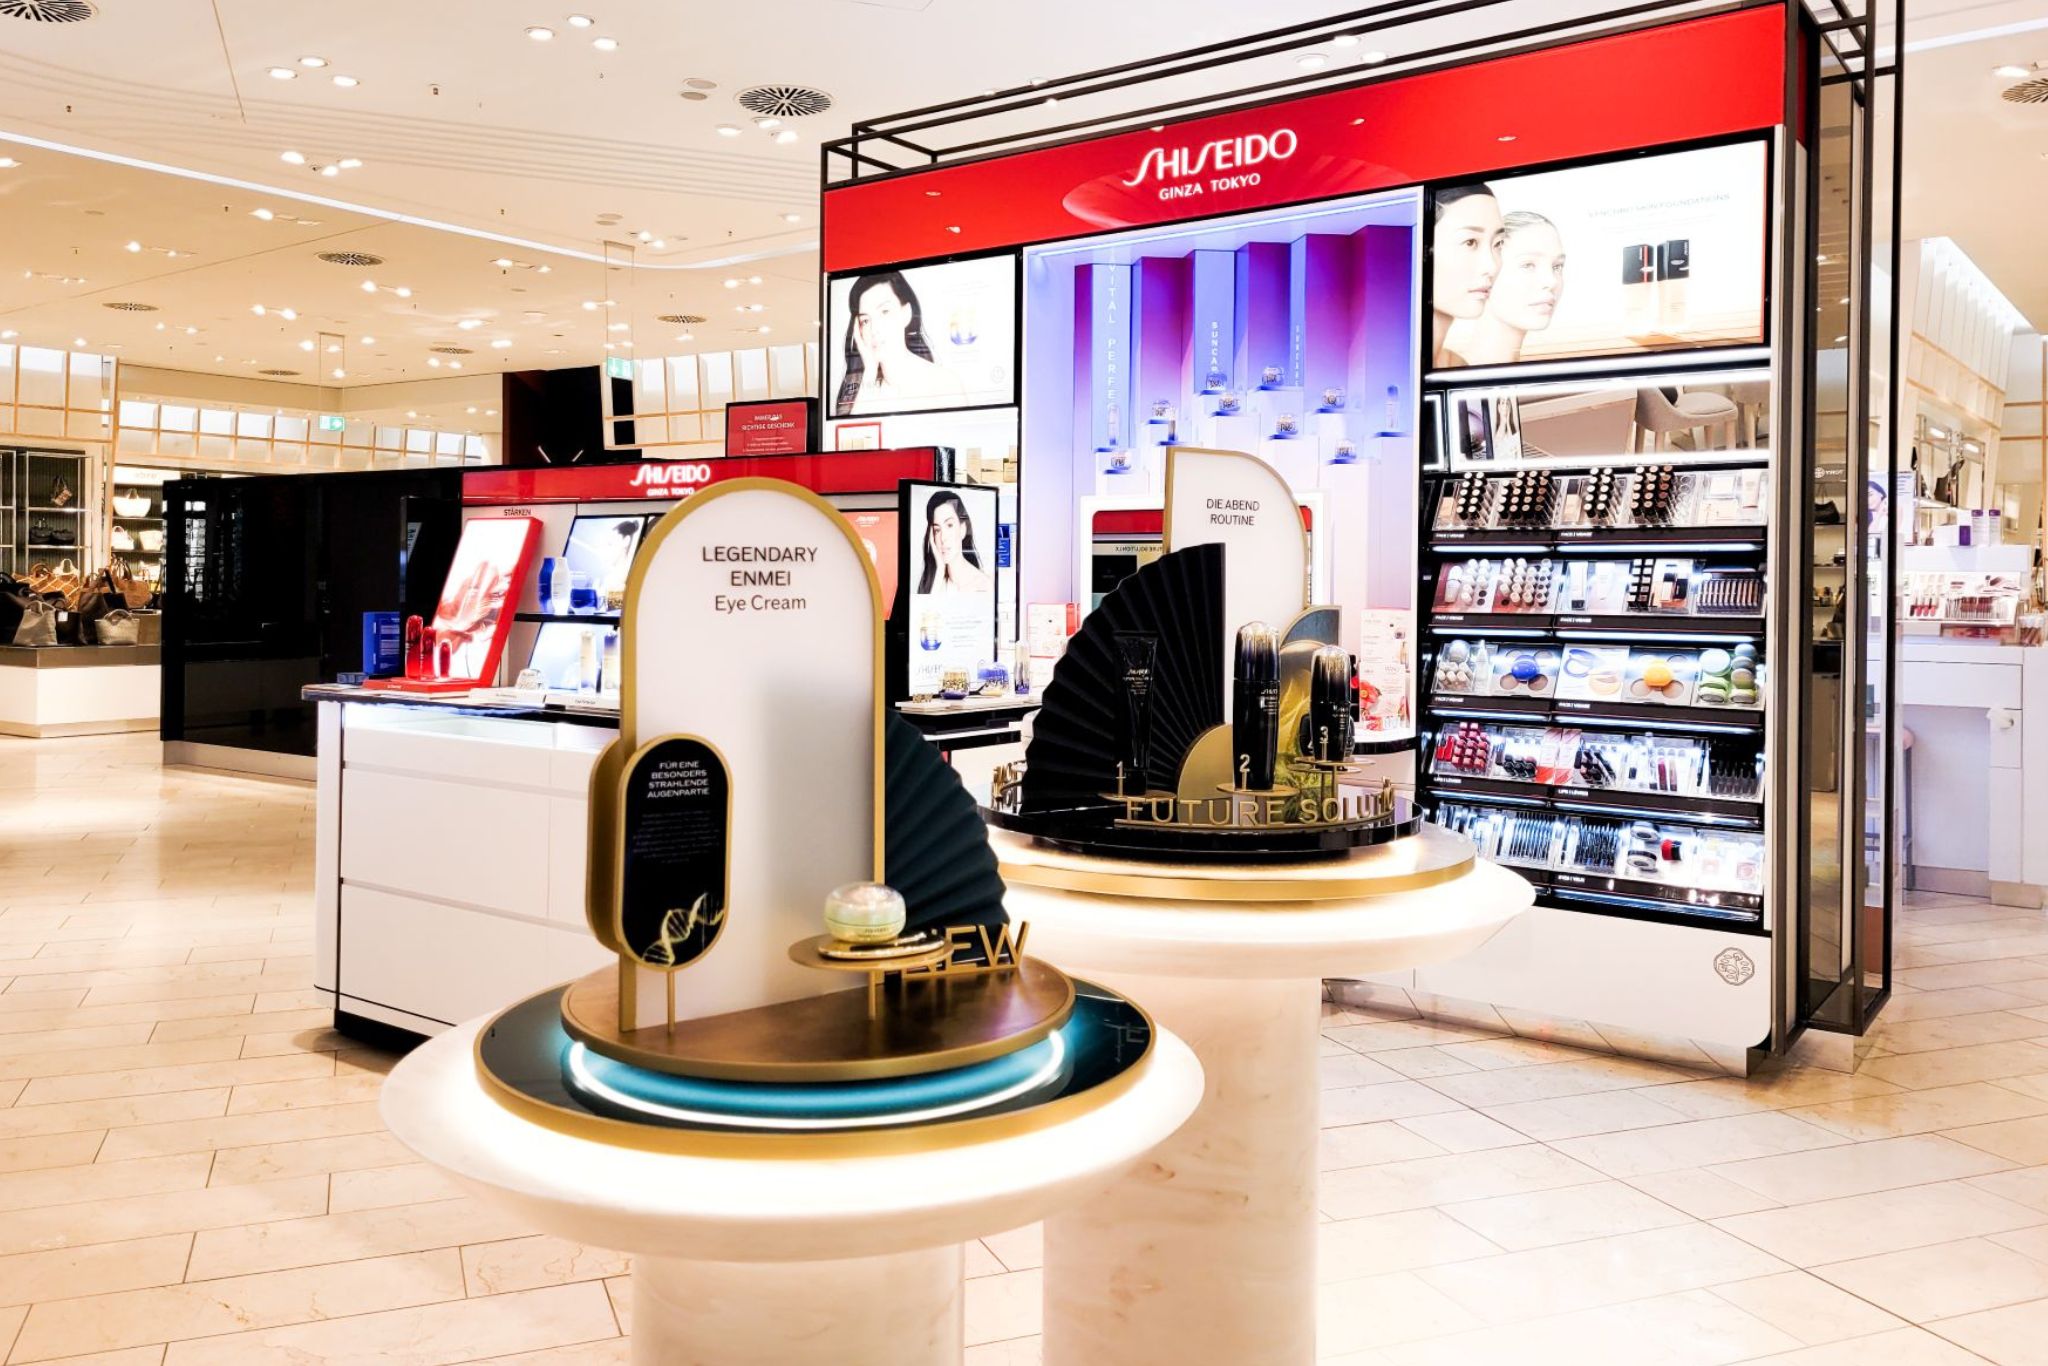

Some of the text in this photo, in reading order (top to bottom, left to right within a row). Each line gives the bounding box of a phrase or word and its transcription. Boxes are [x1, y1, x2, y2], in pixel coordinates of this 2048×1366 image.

[1122, 128, 1297, 187] SHISEIDO
[1159, 172, 1261, 201] GINZA TOKYO
[630, 464, 711, 486] SHISEIDO
[1206, 498, 1260, 511] DIE ABEND
[1210, 513, 1255, 526] ROUTINE
[702, 545, 818, 562] LEGENDARY
[731, 571, 791, 586] ENMEI
[715, 594, 806, 614] Eye Cream
[1320, 726, 1328, 742] 3
[659, 760, 699, 769] FÜR EINE
[1116, 761, 1124, 778] 1
[1240, 754, 1250, 771] 2
[651, 770, 707, 780] BESONDERS
[648, 779, 709, 789] STRAHLENDE
[646, 787, 710, 799] AUGENPARTIE
[1125, 799, 1285, 826] FUTURE
